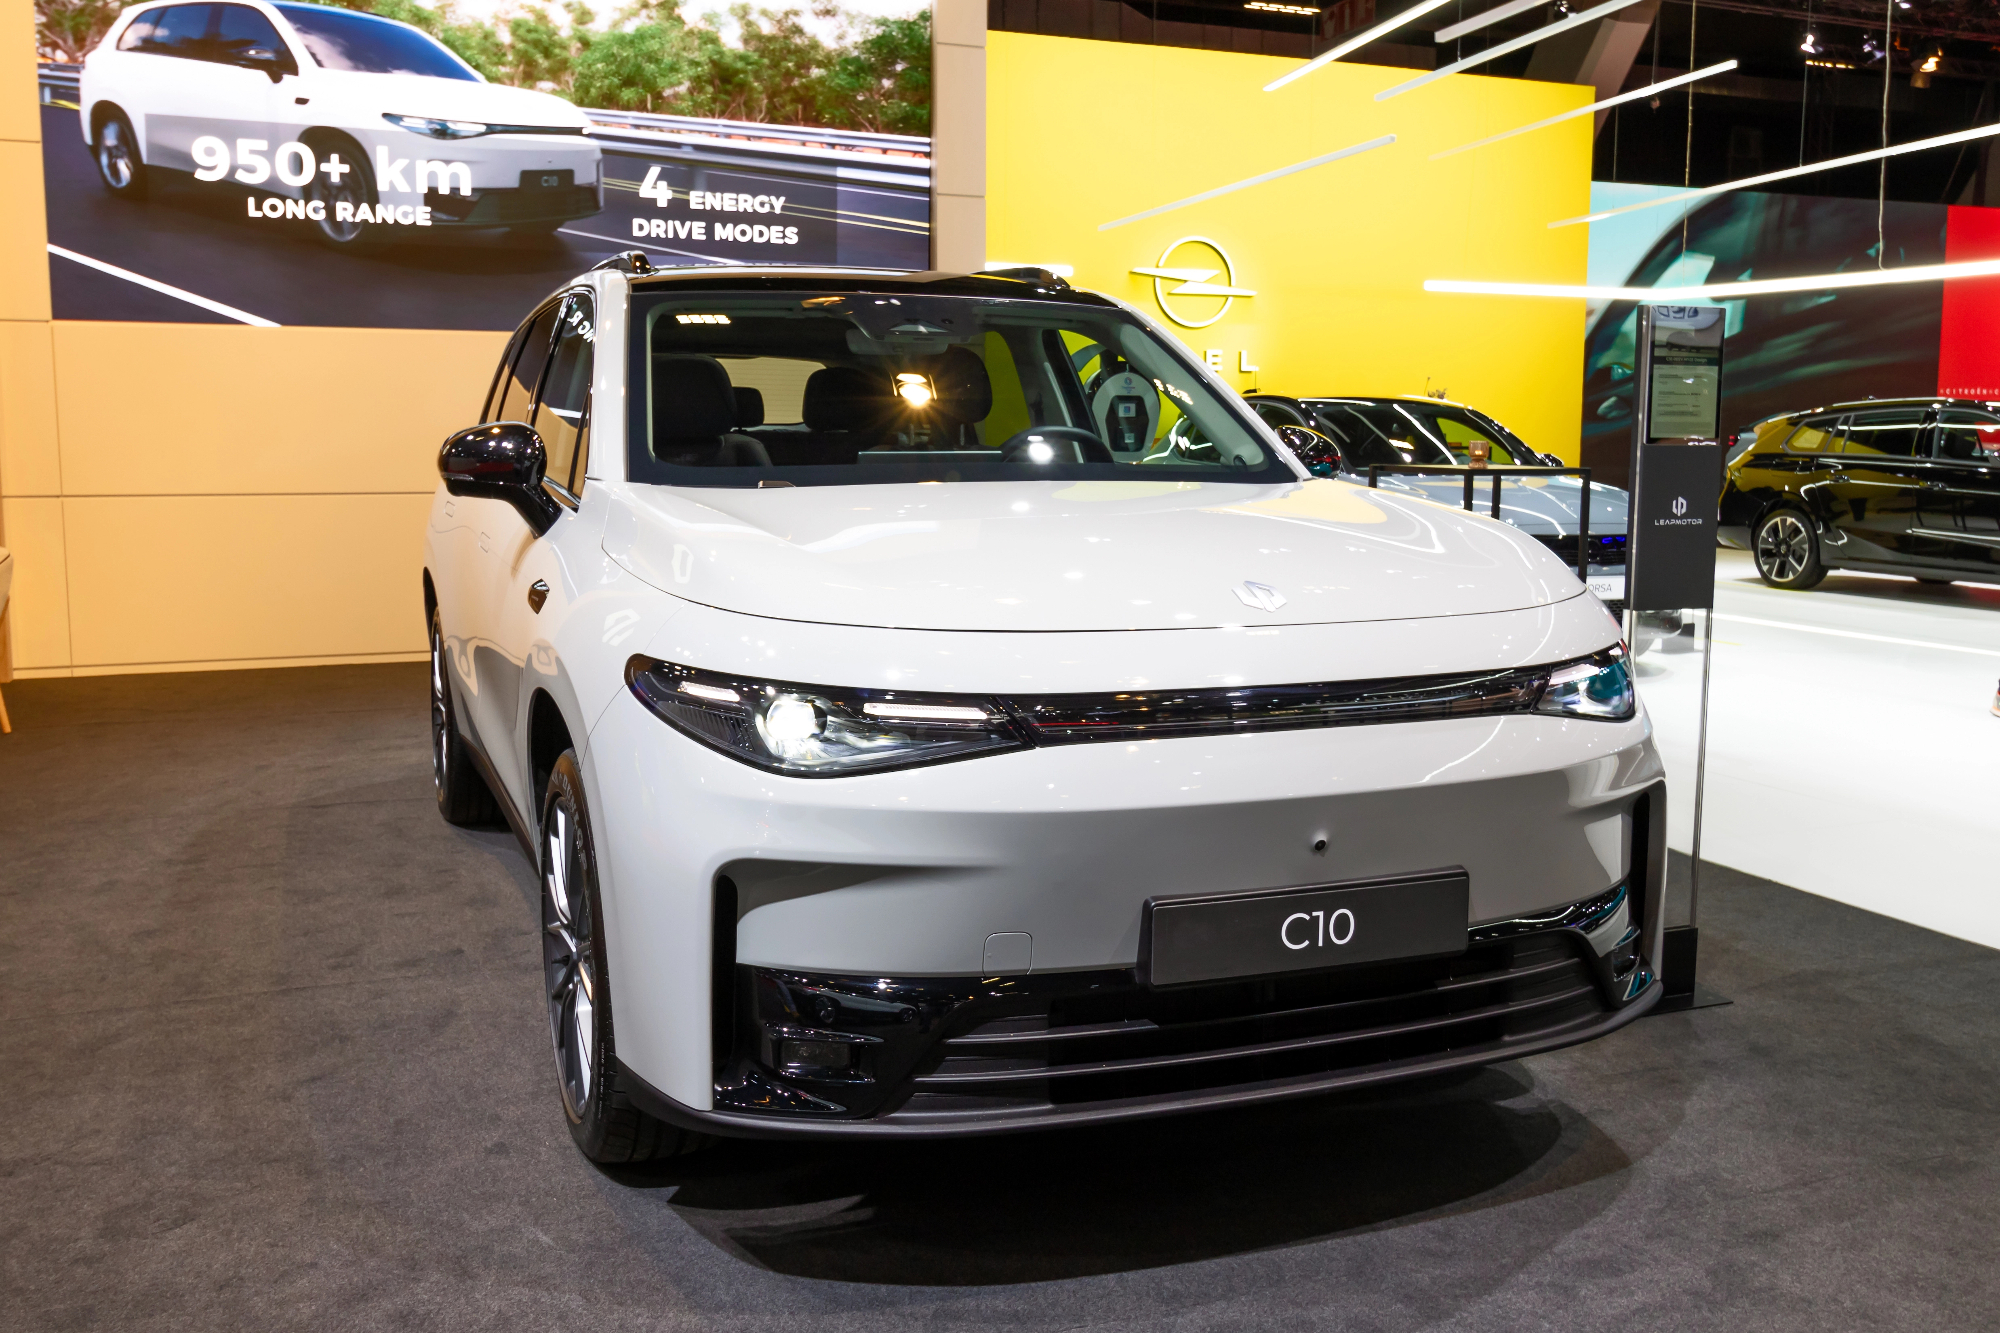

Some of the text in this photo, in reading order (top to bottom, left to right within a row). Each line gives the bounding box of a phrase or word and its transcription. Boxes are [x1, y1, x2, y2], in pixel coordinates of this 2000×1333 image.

[190, 135, 472, 197] 950+ km
[638, 166, 786, 214] 4 ENERGY
[247, 197, 432, 226] LONG RANGE
[632, 217, 799, 245] DRIVE MODES
[1204, 349, 1260, 372] EL
[1654, 518, 1703, 526] LEAPMOTOR
[1587, 583, 1612, 592] ORSA
[1281, 908, 1355, 950] C10
